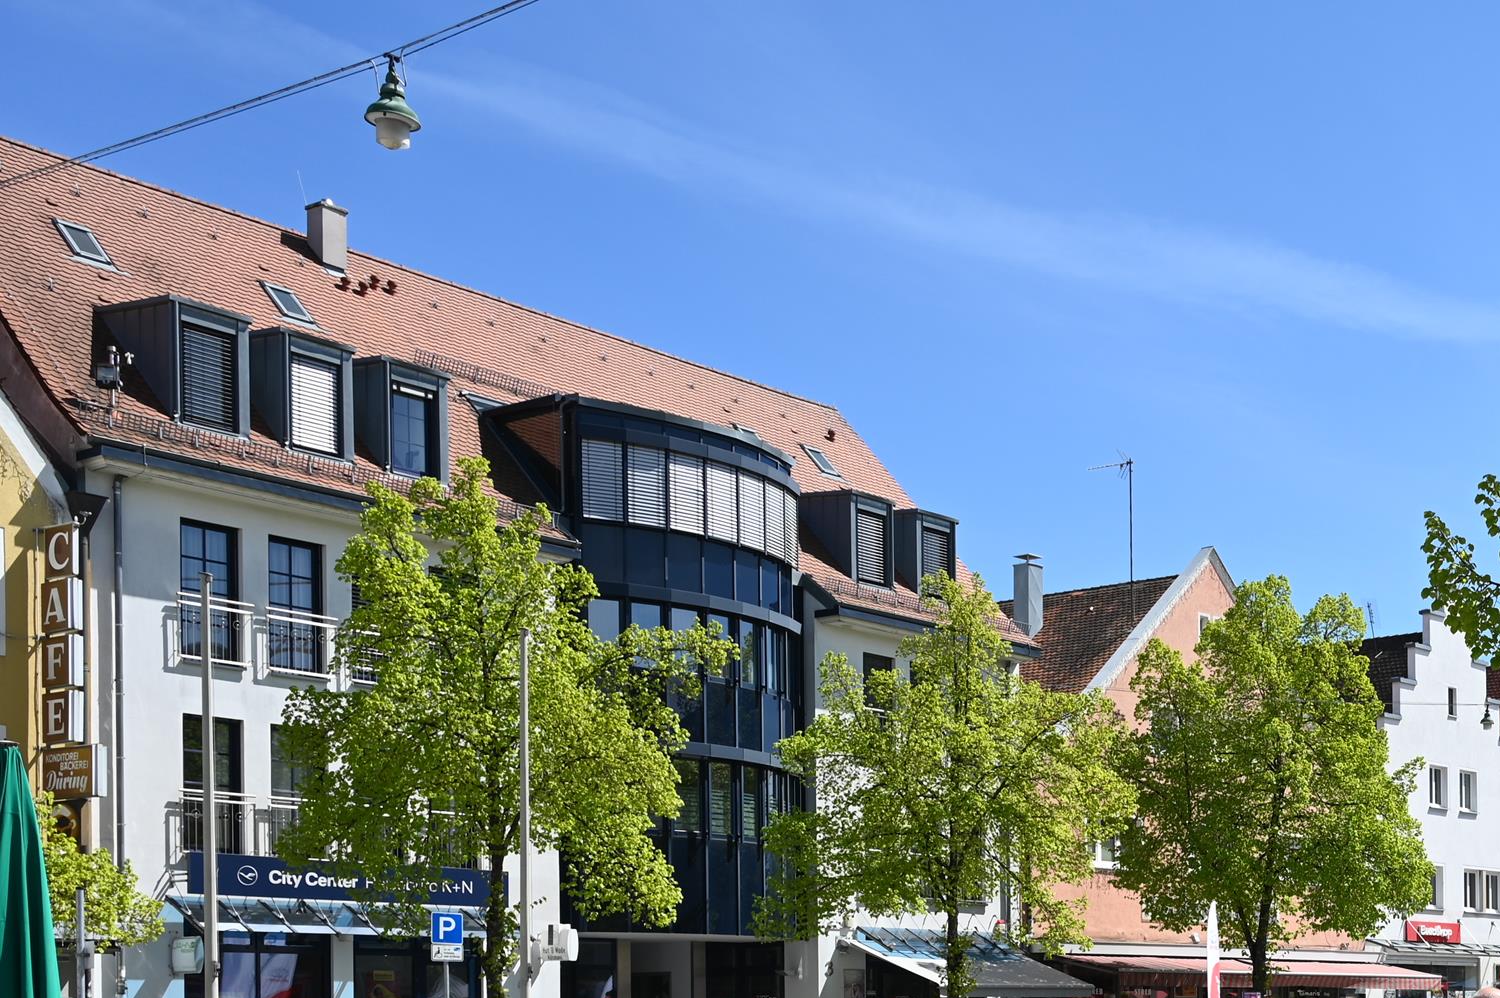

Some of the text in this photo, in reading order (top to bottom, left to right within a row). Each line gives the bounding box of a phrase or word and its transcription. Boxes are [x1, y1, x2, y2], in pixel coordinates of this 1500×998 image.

[46, 770, 89, 793] Düring
[268, 869, 302, 888] City
[305, 872, 359, 888] Center
[439, 916, 456, 940] P
